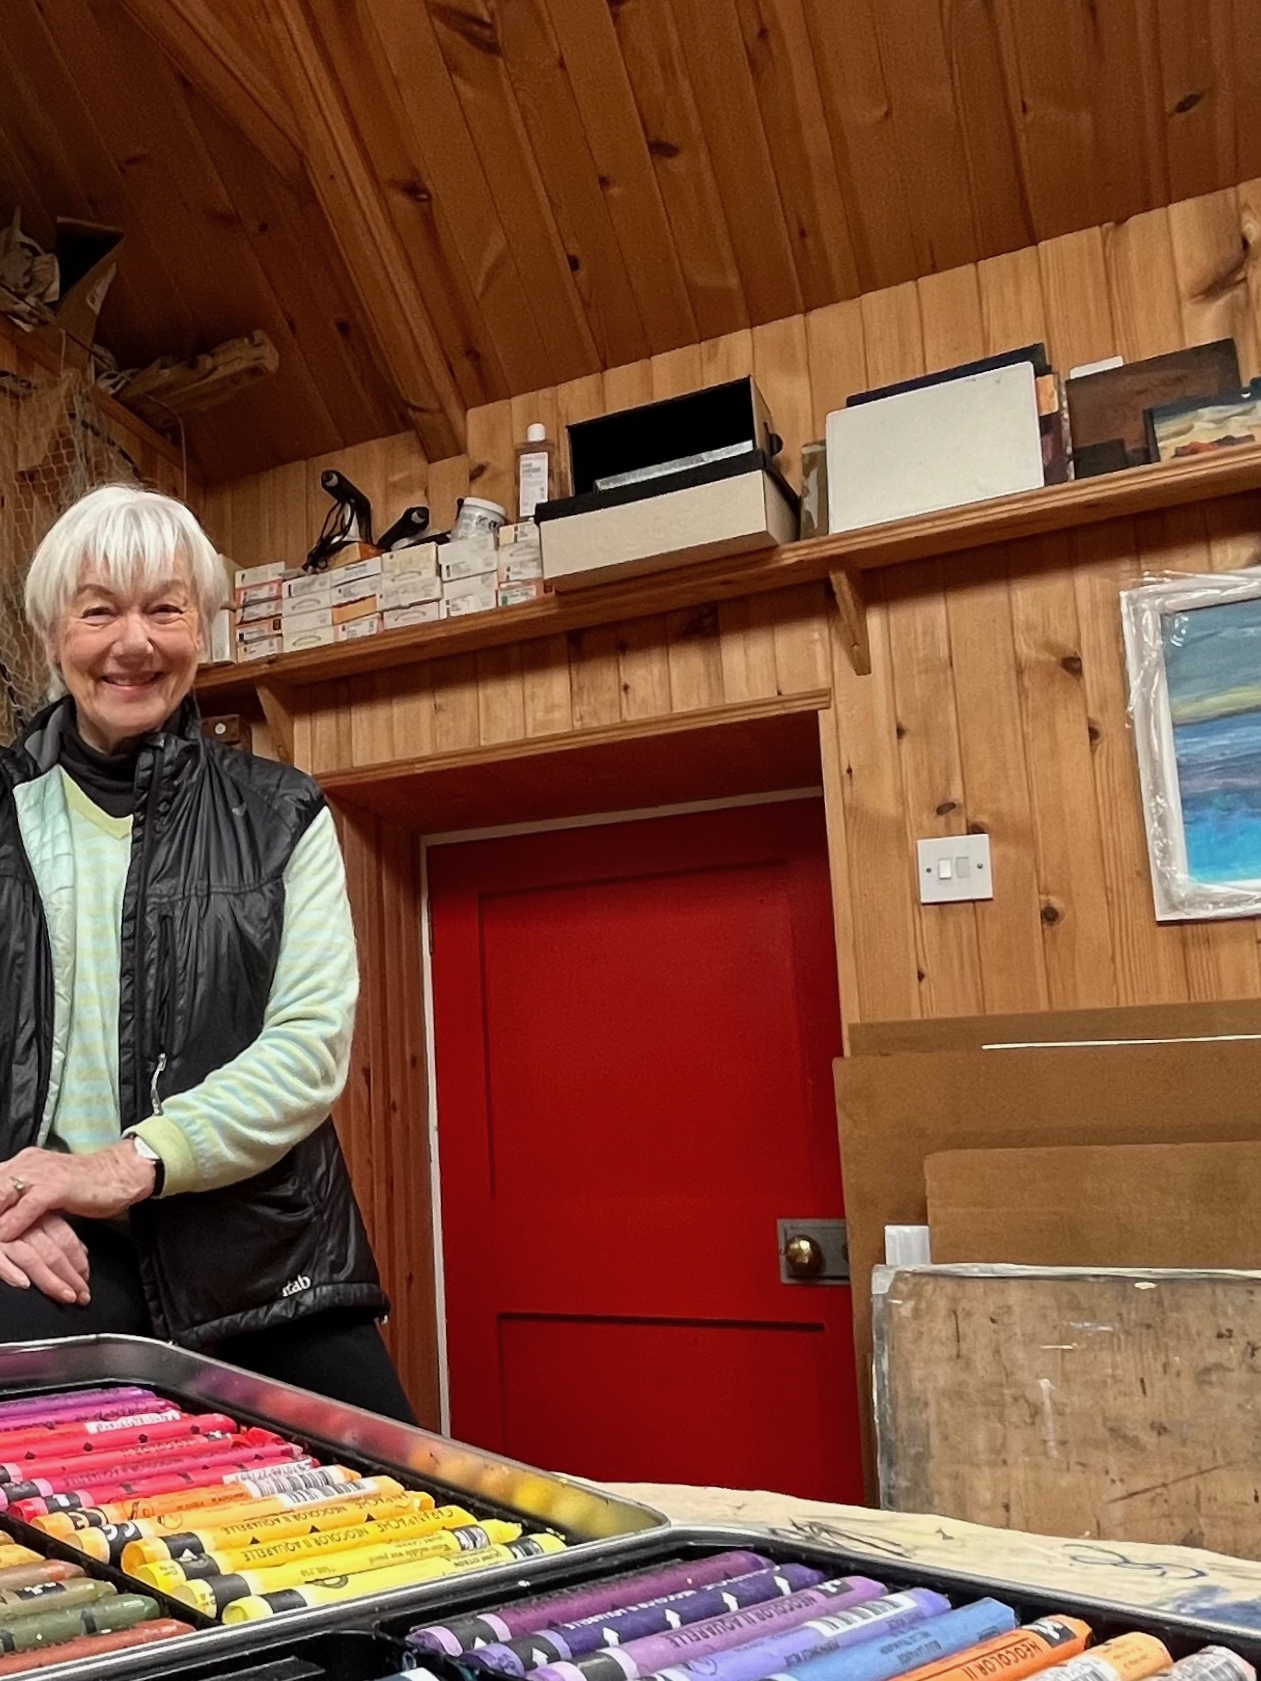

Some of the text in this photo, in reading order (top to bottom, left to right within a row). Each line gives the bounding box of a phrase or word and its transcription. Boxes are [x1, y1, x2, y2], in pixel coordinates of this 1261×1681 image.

[317, 1526, 370, 1546] NEOCOLOR
[241, 1538, 303, 1562] AQUARELLE
[979, 1642, 1044, 1674] NEOCOLOR
